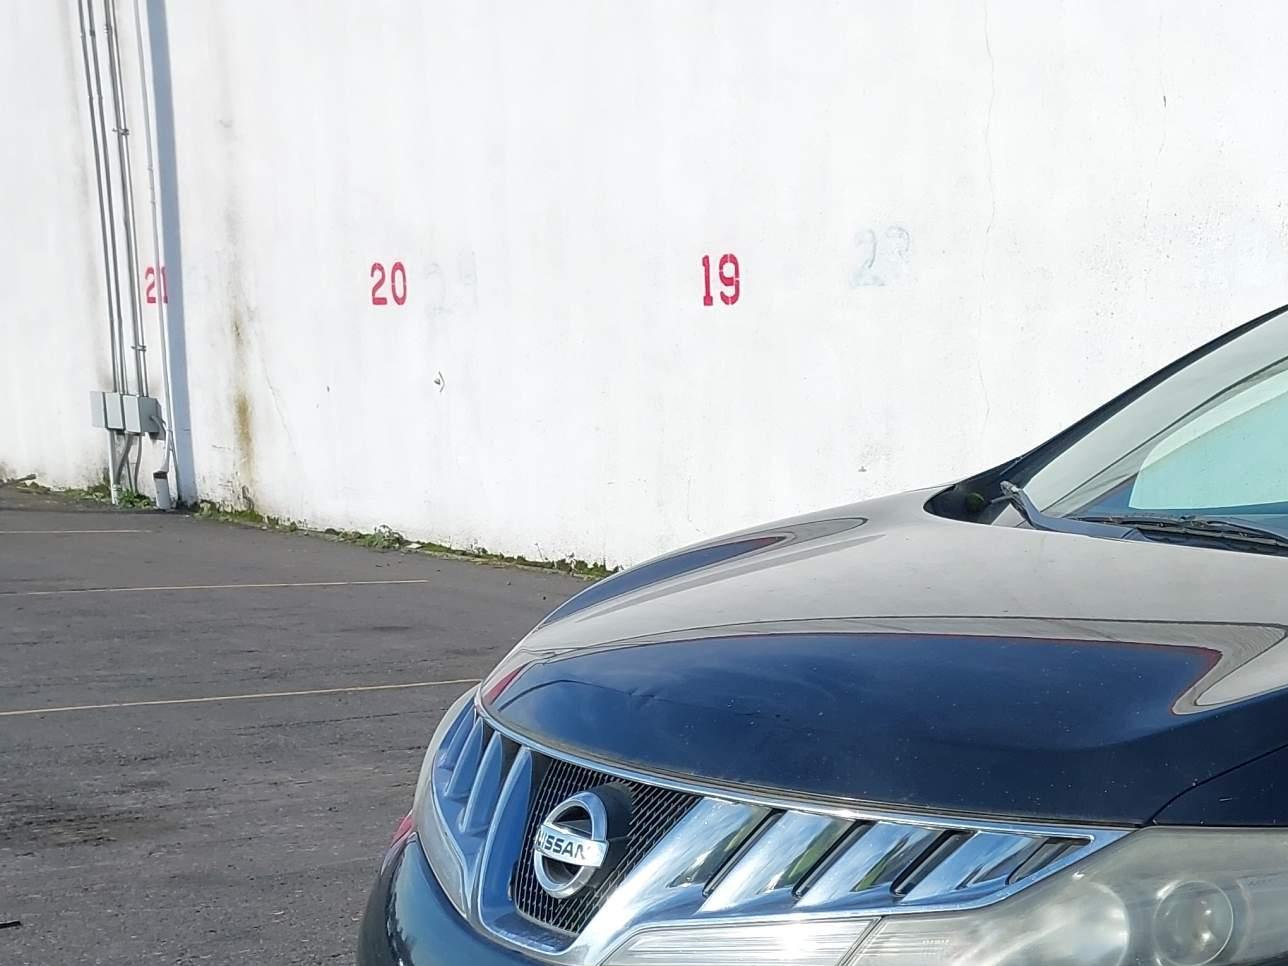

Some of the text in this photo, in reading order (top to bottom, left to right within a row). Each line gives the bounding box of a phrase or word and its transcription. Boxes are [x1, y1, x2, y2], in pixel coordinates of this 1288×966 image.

[144, 266, 169, 304] 21
[371, 261, 407, 306] 20
[701, 253, 740, 307] 19
